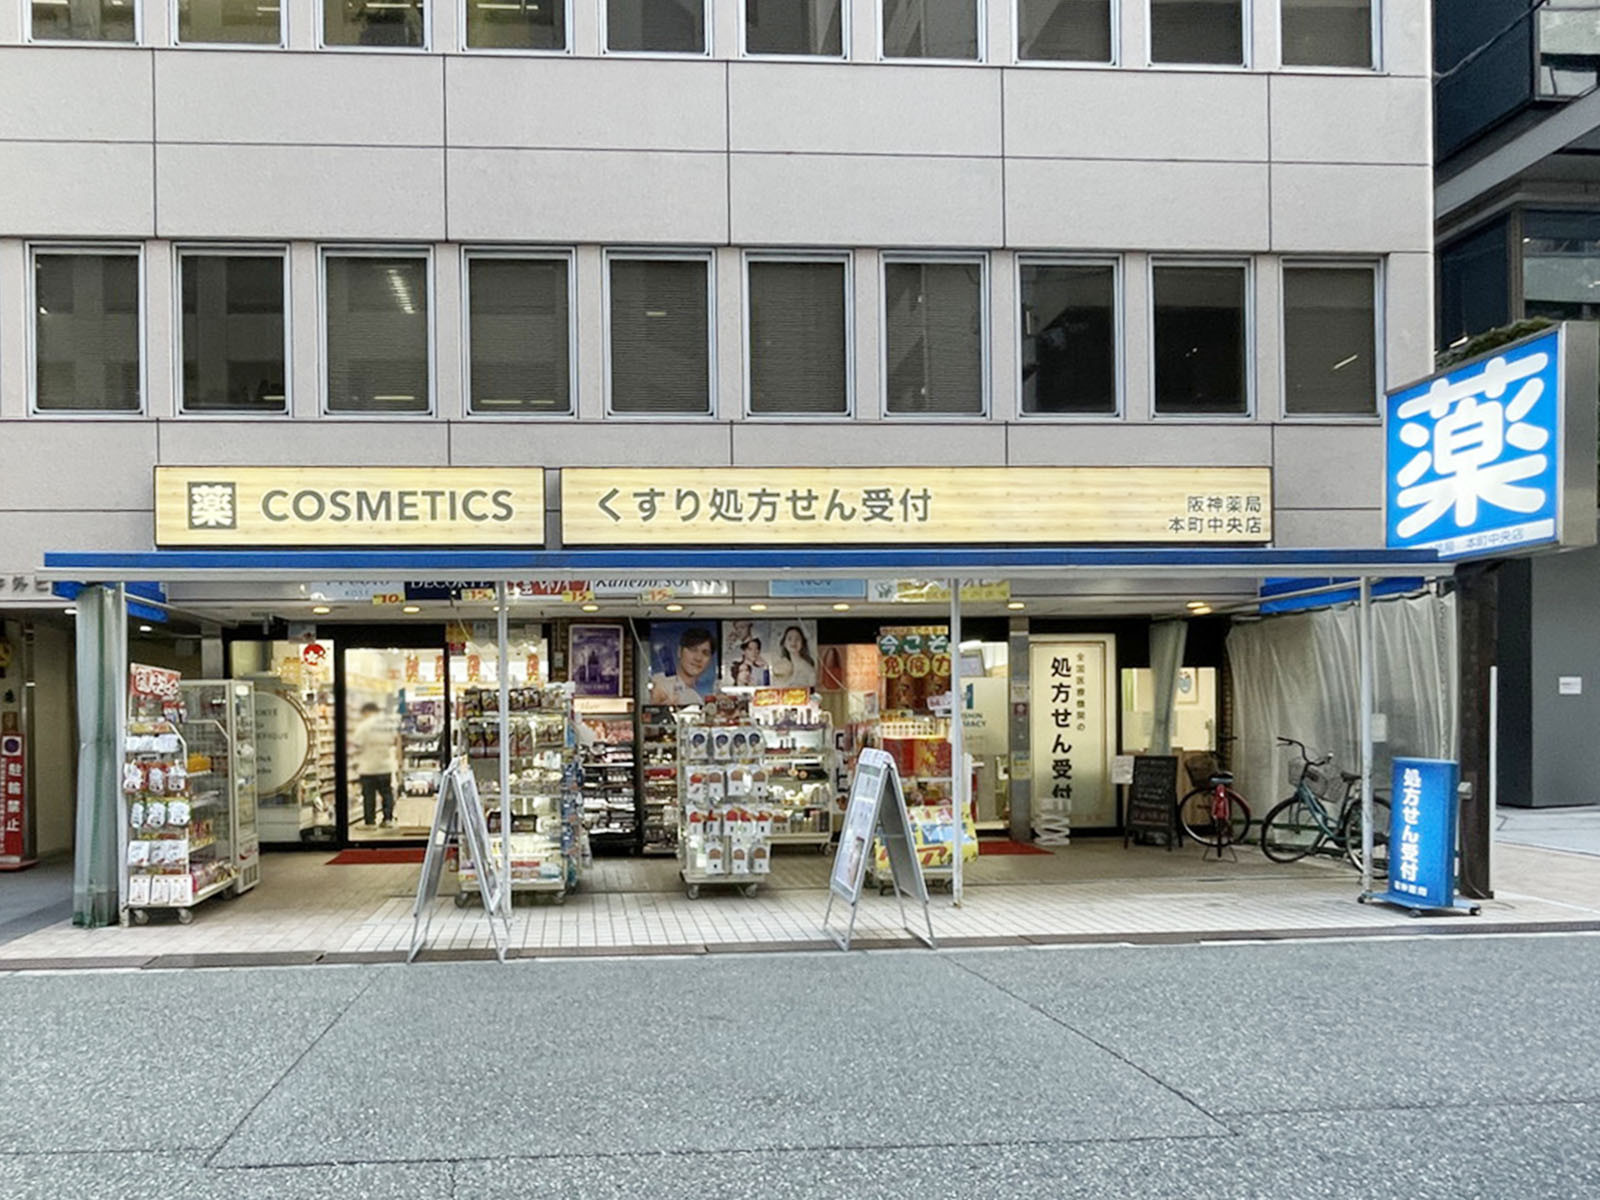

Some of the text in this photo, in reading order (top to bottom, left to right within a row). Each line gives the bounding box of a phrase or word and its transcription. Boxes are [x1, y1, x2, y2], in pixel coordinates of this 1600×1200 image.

[1396, 352, 1549, 538] 薬
[188, 482, 236, 529] 薬
[262, 489, 513, 522] COSMETICS
[598, 488, 932, 522] くすり処方せん受付
[1187, 495, 1261, 513] 阪神薬局
[1168, 516, 1262, 534] 本町中央店
[880, 634, 948, 656] 今こそ
[1051, 656, 1072, 799] 処方せん受付
[1400, 767, 1422, 882] 処方せん受付
